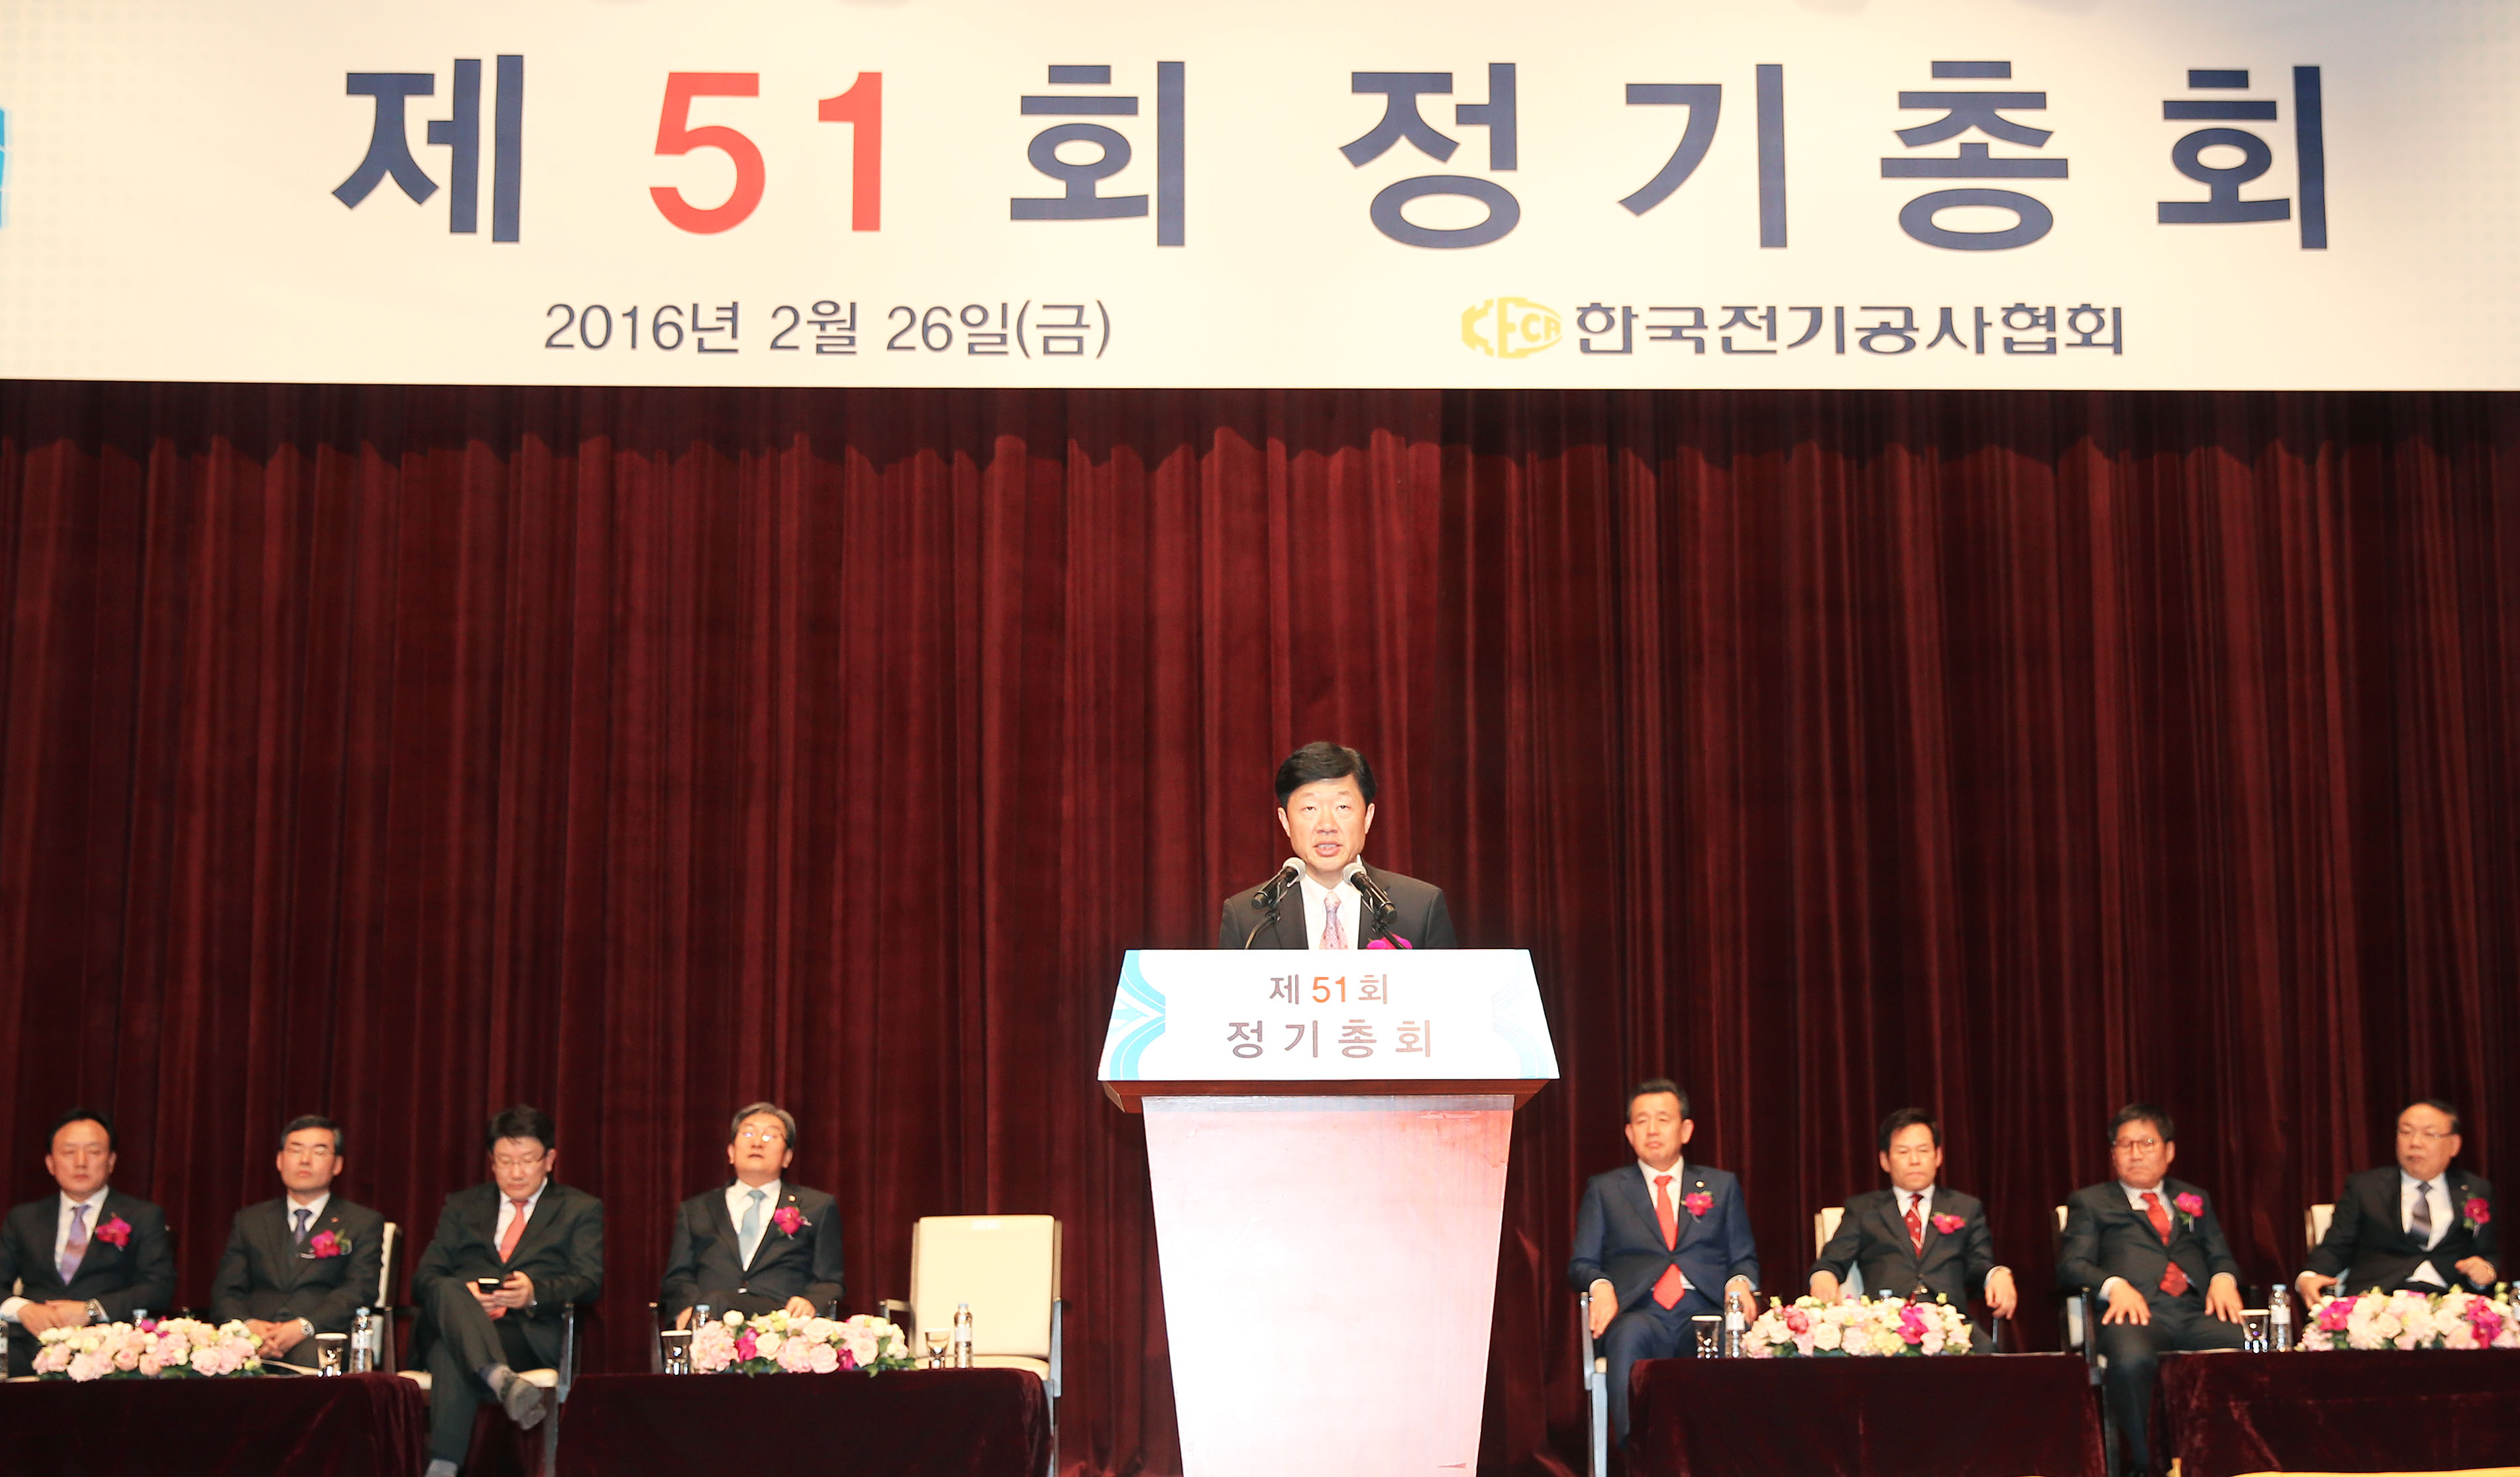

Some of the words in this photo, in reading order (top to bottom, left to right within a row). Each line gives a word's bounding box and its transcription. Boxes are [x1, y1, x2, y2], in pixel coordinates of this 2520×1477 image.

[649, 71, 883, 235] 51
[544, 301, 739, 354] 2016년
[769, 300, 857, 355] 2월
[886, 300, 1111, 358] 26일(금)
[1575, 302, 2124, 356] 한국전기공사협회
